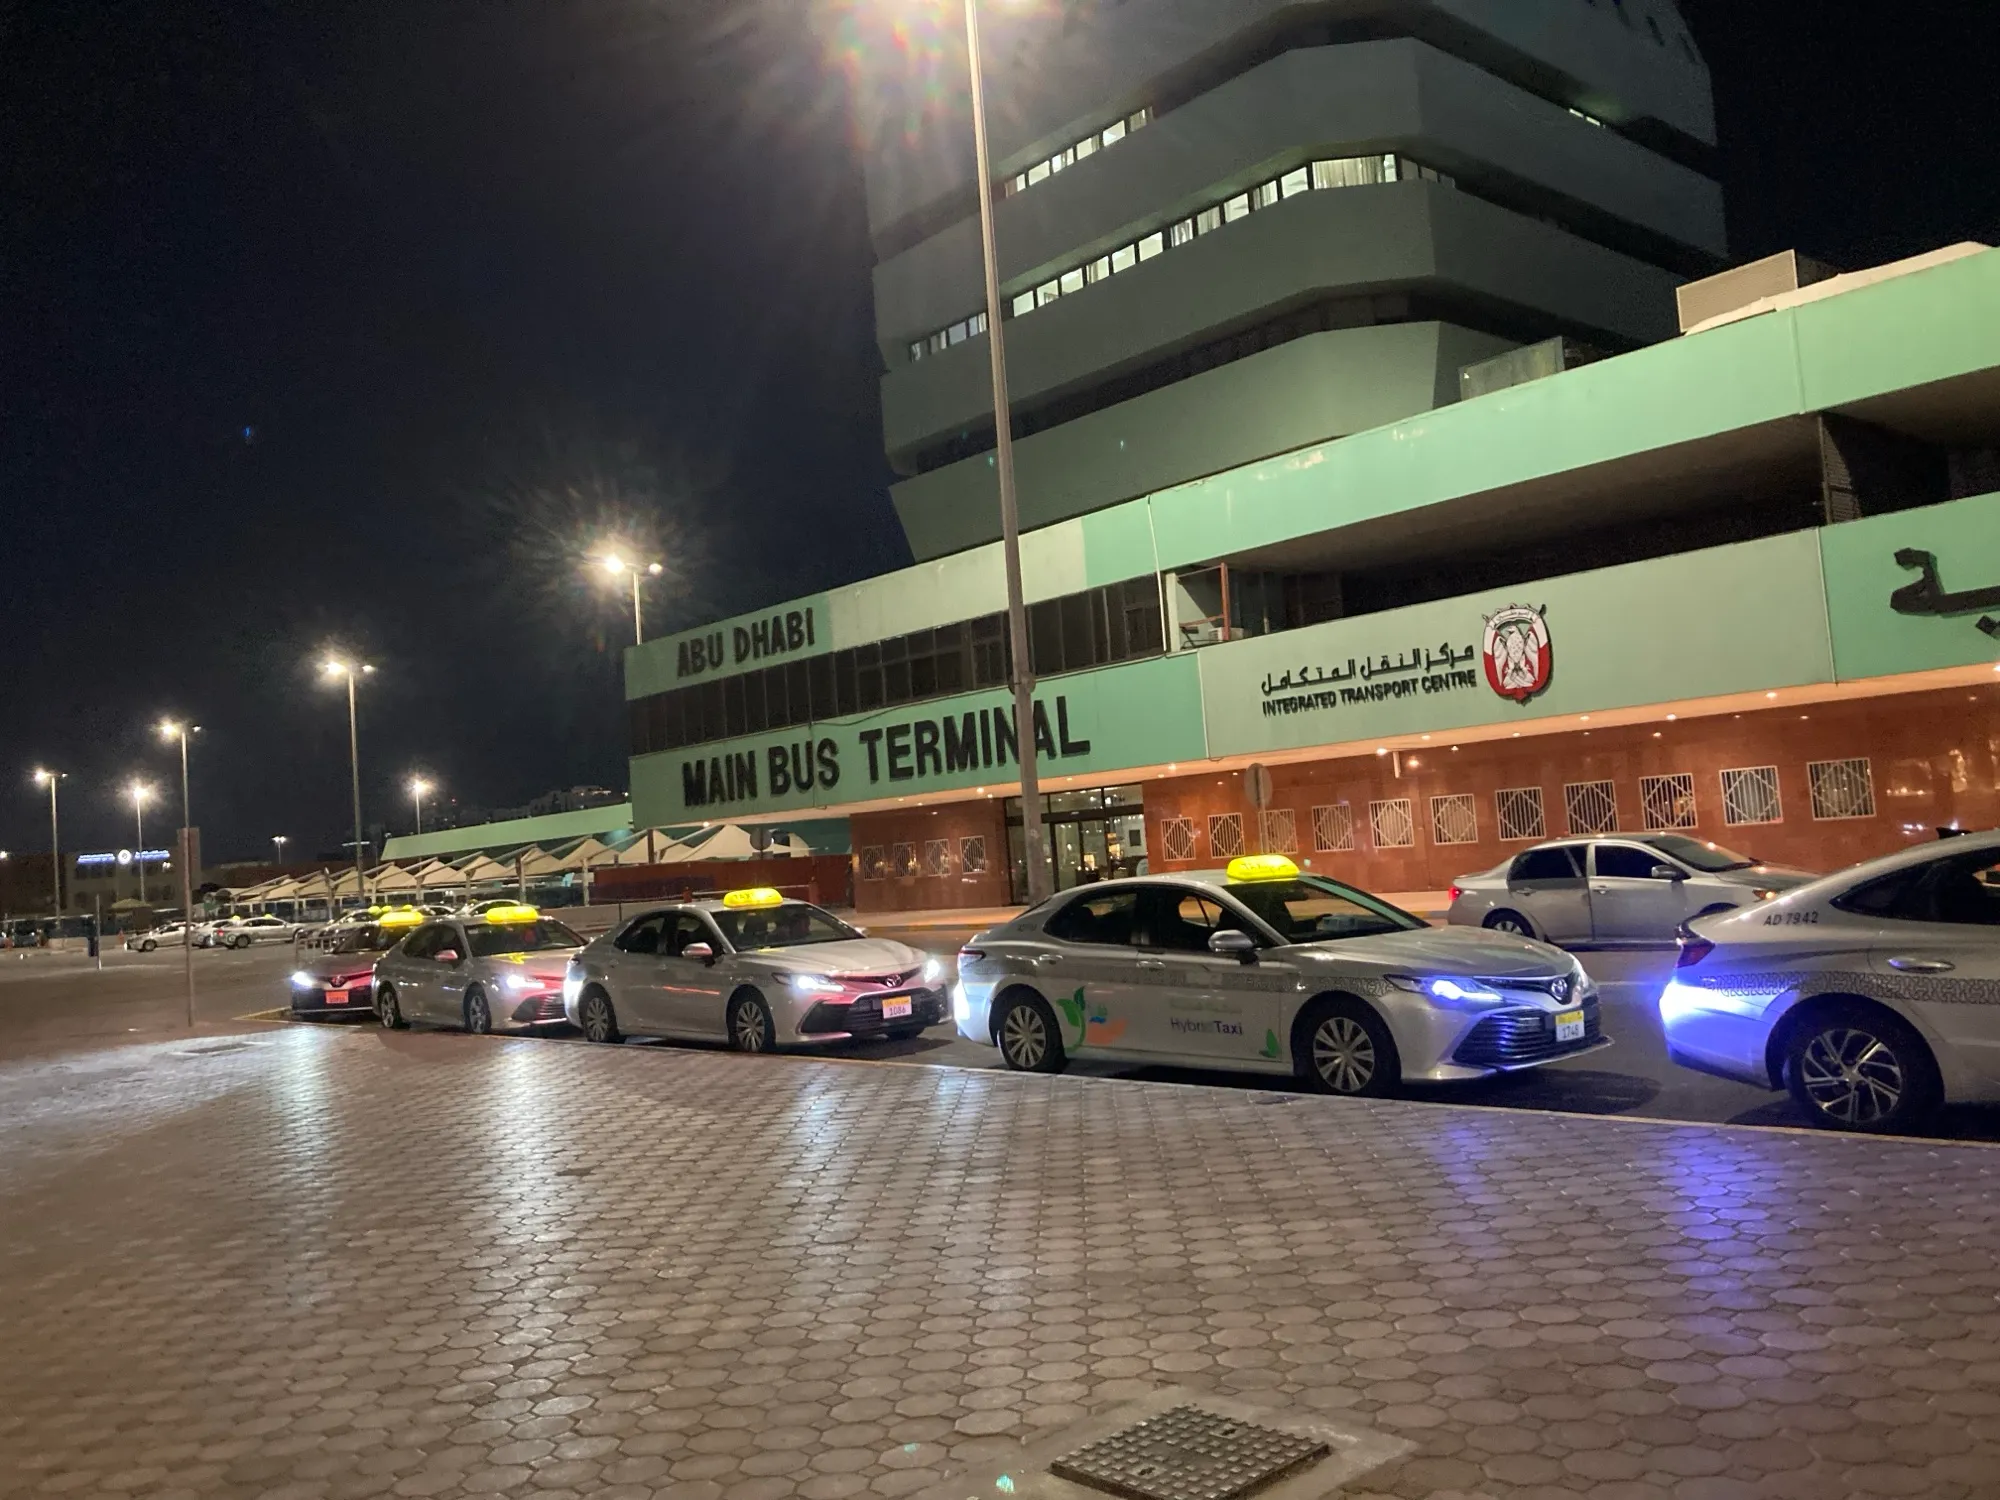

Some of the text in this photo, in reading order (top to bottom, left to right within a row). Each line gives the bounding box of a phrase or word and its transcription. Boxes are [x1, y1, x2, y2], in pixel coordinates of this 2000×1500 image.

[677, 606, 815, 679] ABU DHABI
[1261, 642, 1475, 697] مركز النقل المتكامل
[1262, 668, 1477, 717] INTEGRATED TRANSPORT CENTRE
[682, 695, 1091, 807] MAIN BUS TERMINAL
[1763, 910, 1819, 926] AD 7942
[1170, 1016, 1243, 1036] Hybr Taxi
